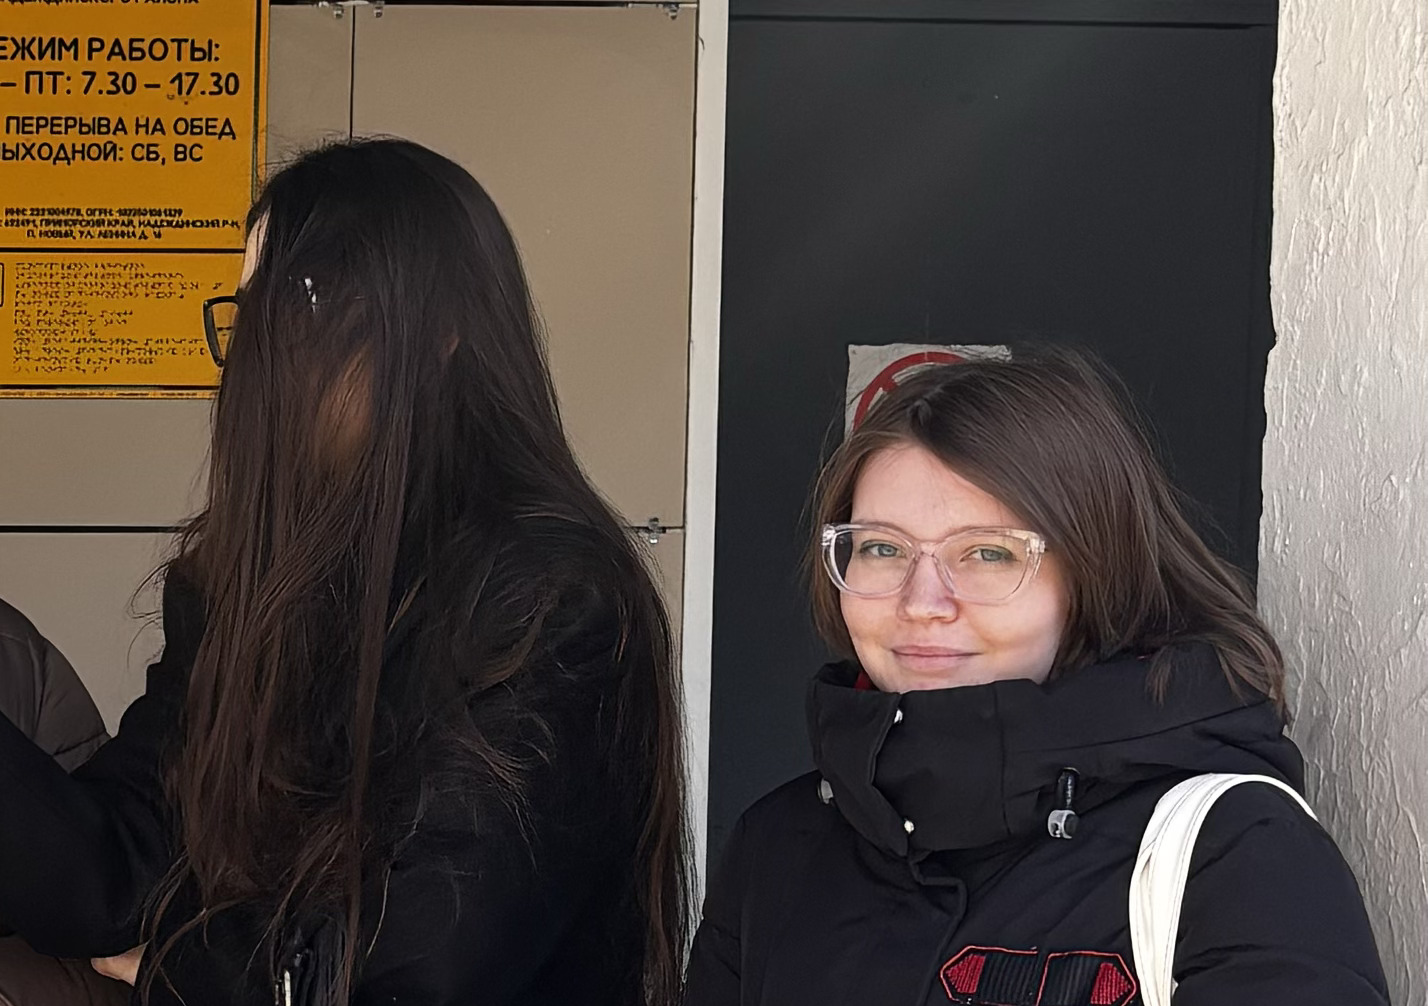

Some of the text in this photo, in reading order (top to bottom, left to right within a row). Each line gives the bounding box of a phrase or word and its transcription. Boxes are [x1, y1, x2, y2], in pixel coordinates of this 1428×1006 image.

[87, 37, 220, 62] РАБОТЫ:
[25, 71, 72, 95] ПТ:
[82, 71, 137, 95] 7.30
[168, 72, 240, 96] 17.30
[6, 116, 127, 135] ПЕРЕРЫВА
[135, 117, 166, 135] НА
[173, 117, 236, 140] ОБЕД
[131, 143, 166, 166] СБ,
[174, 144, 204, 162] ВС
